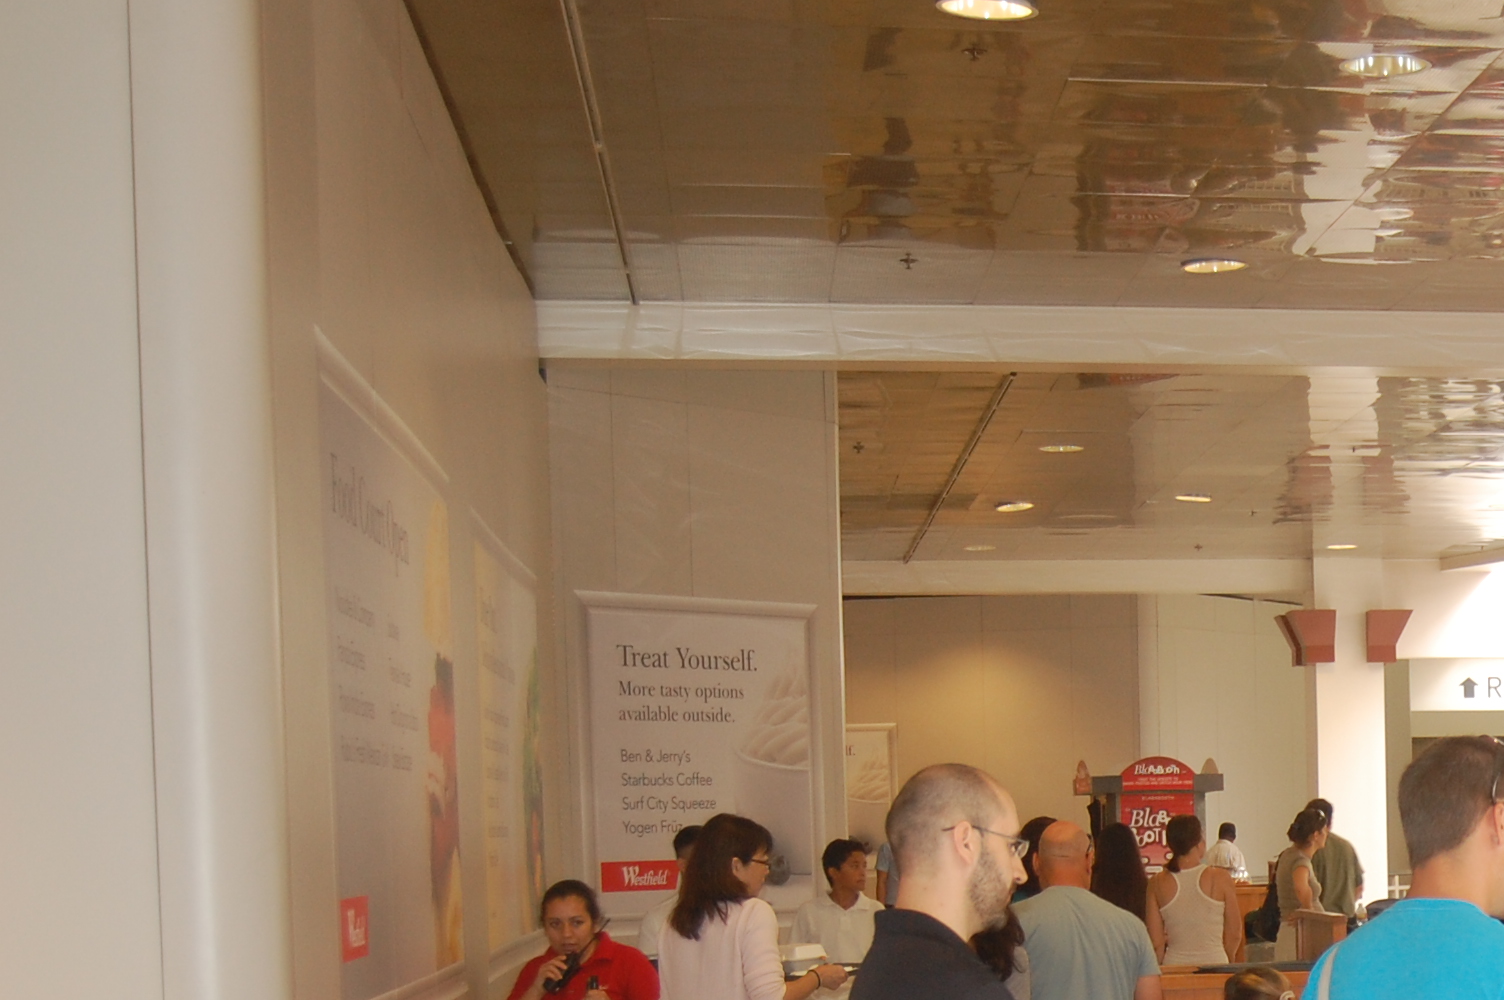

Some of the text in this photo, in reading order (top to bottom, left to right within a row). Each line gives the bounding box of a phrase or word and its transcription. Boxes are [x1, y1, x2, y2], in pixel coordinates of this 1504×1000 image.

[616, 644, 758, 672] Treat Yourself.
[618, 681, 744, 703] More tasty options
[618, 706, 735, 723] available outside.
[621, 750, 691, 766] Ben & Jerry's
[621, 773, 712, 787] Starbucks Coffee
[622, 797, 716, 813] Surf City Squeeze
[622, 820, 658, 837] Yogen
[622, 865, 669, 887] Westfield
